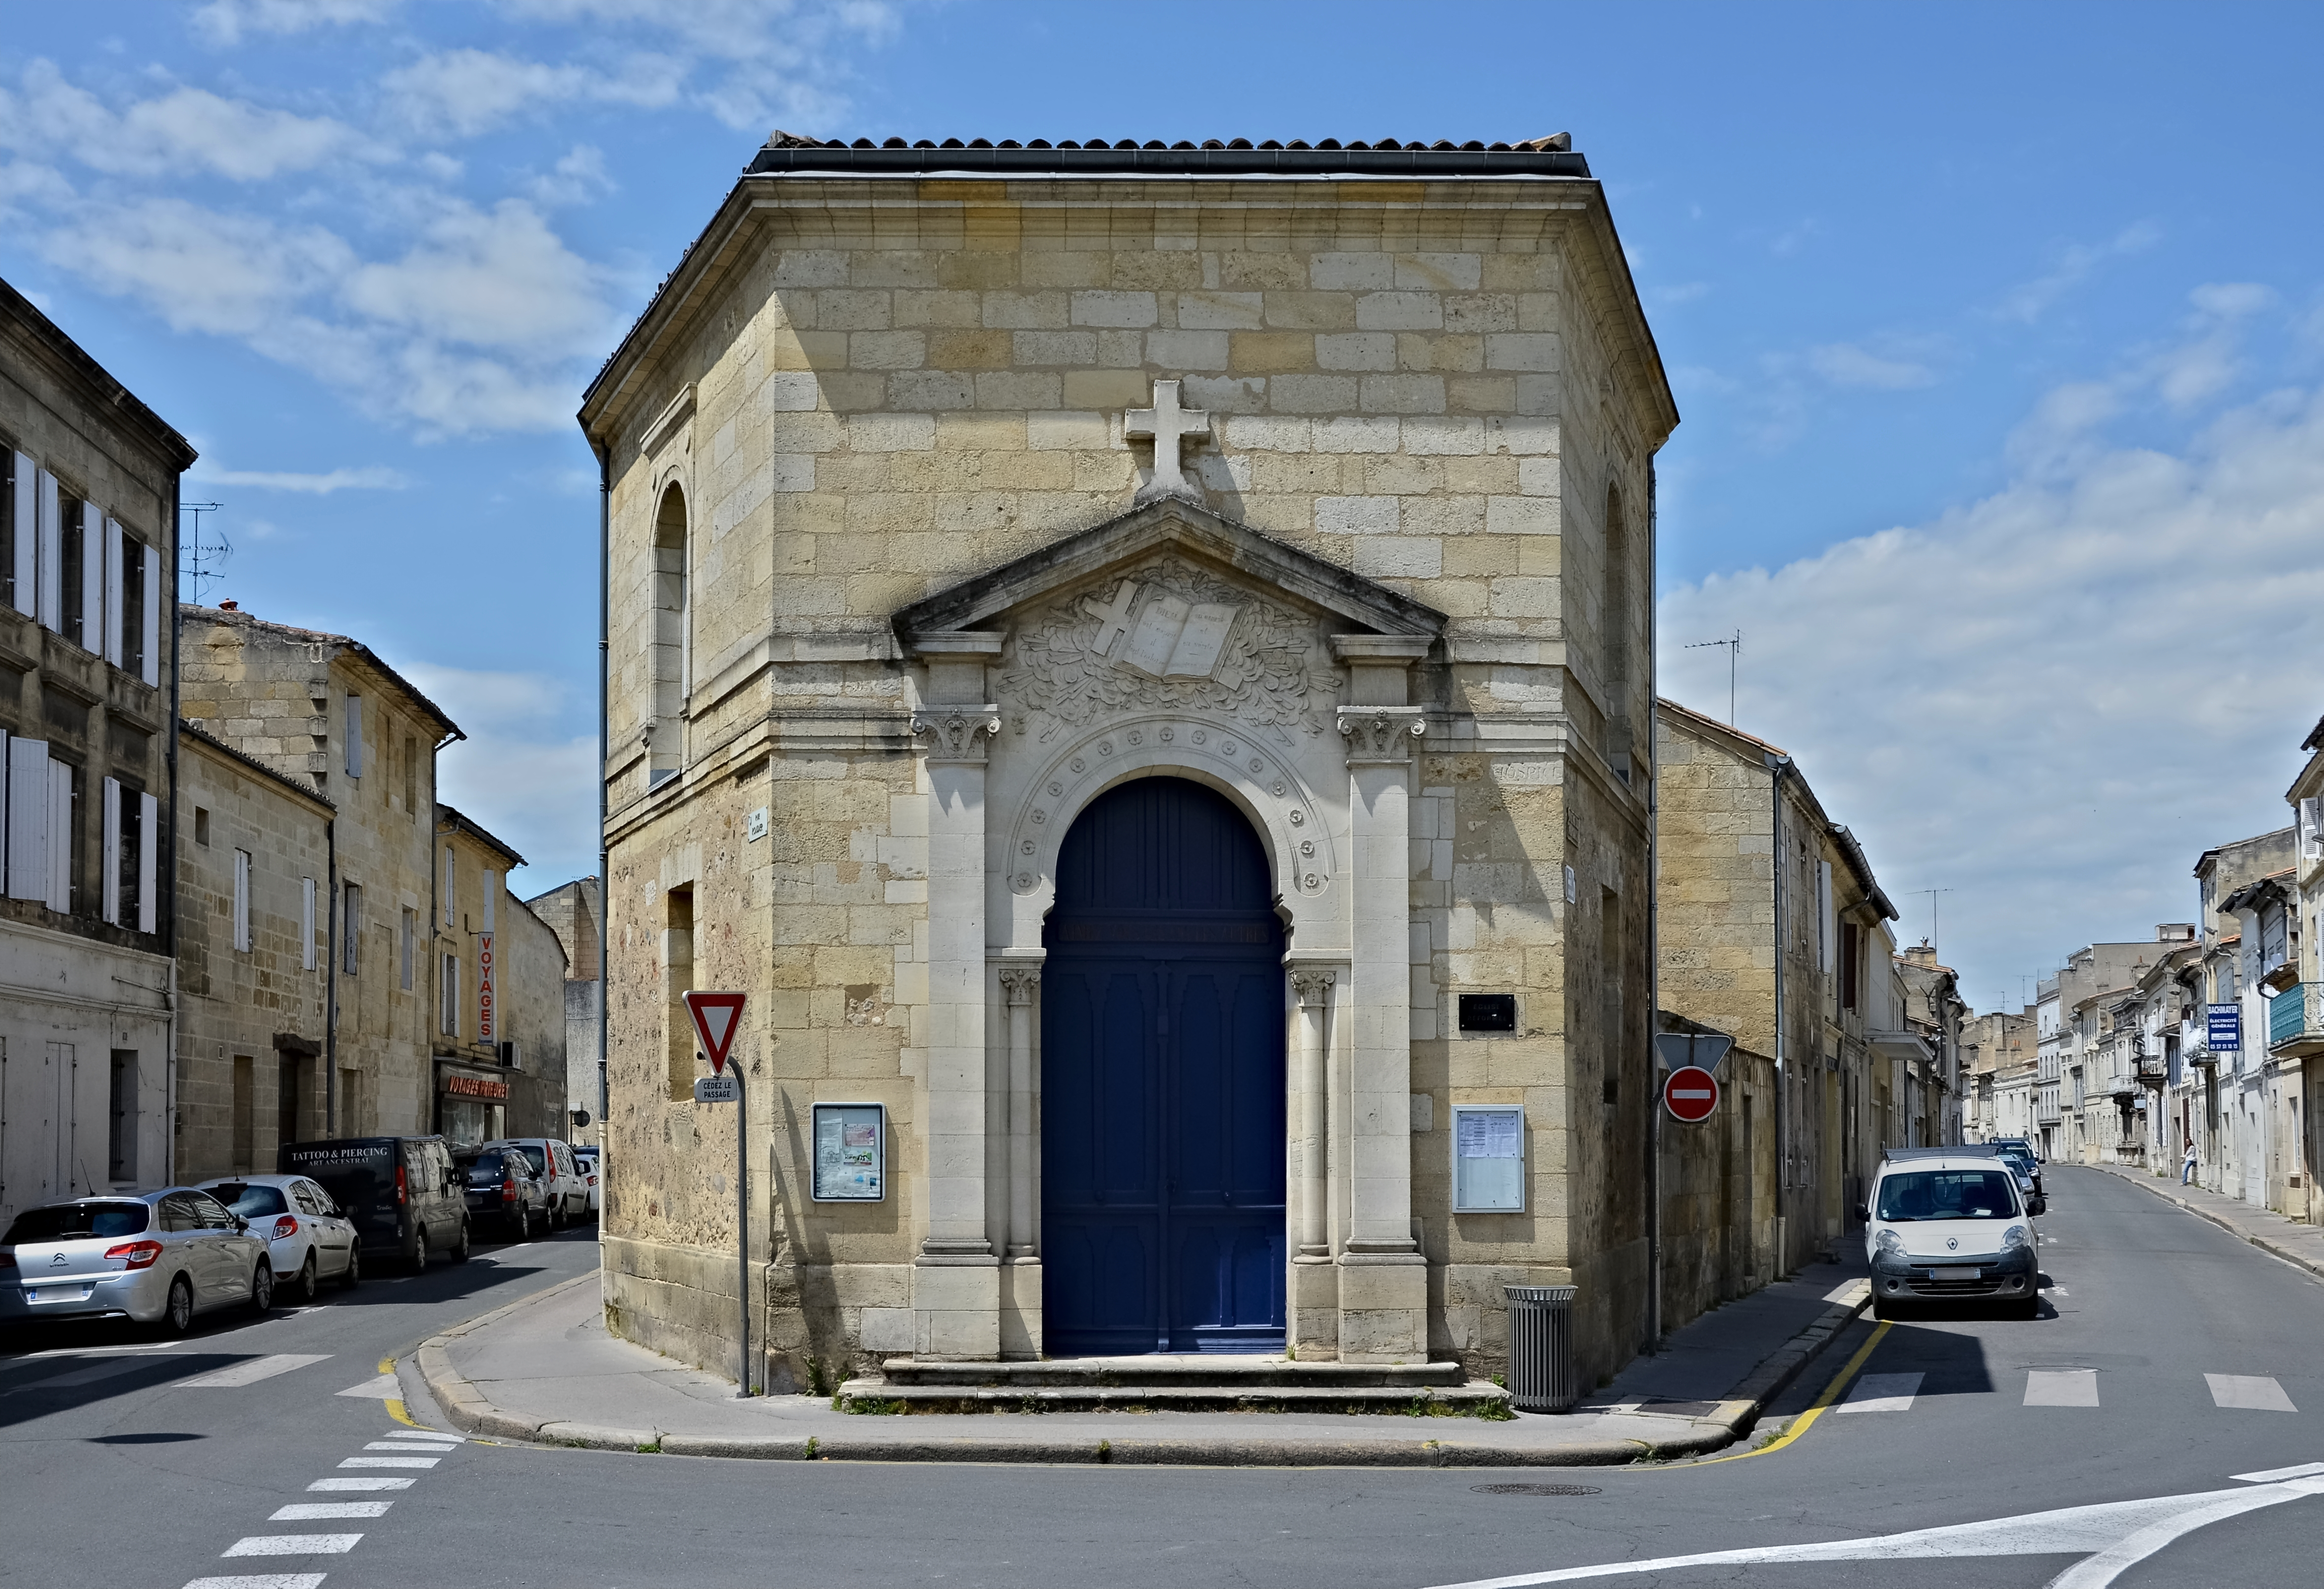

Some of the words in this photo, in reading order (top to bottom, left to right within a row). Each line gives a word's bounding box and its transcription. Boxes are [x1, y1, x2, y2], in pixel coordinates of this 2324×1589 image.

[480, 937, 492, 1036] VOYAGES
[2208, 1005, 2238, 1014] BACHMAYER
[450, 1076, 479, 1095] VOYAGES
[480, 1081, 510, 1099] PRIEURET
[703, 1081, 722, 1090] CÉDEZ
[292, 1150, 329, 1161] TATTOO
[331, 1150, 338, 1158] &
[341, 1148, 388, 1157] PIERCING
